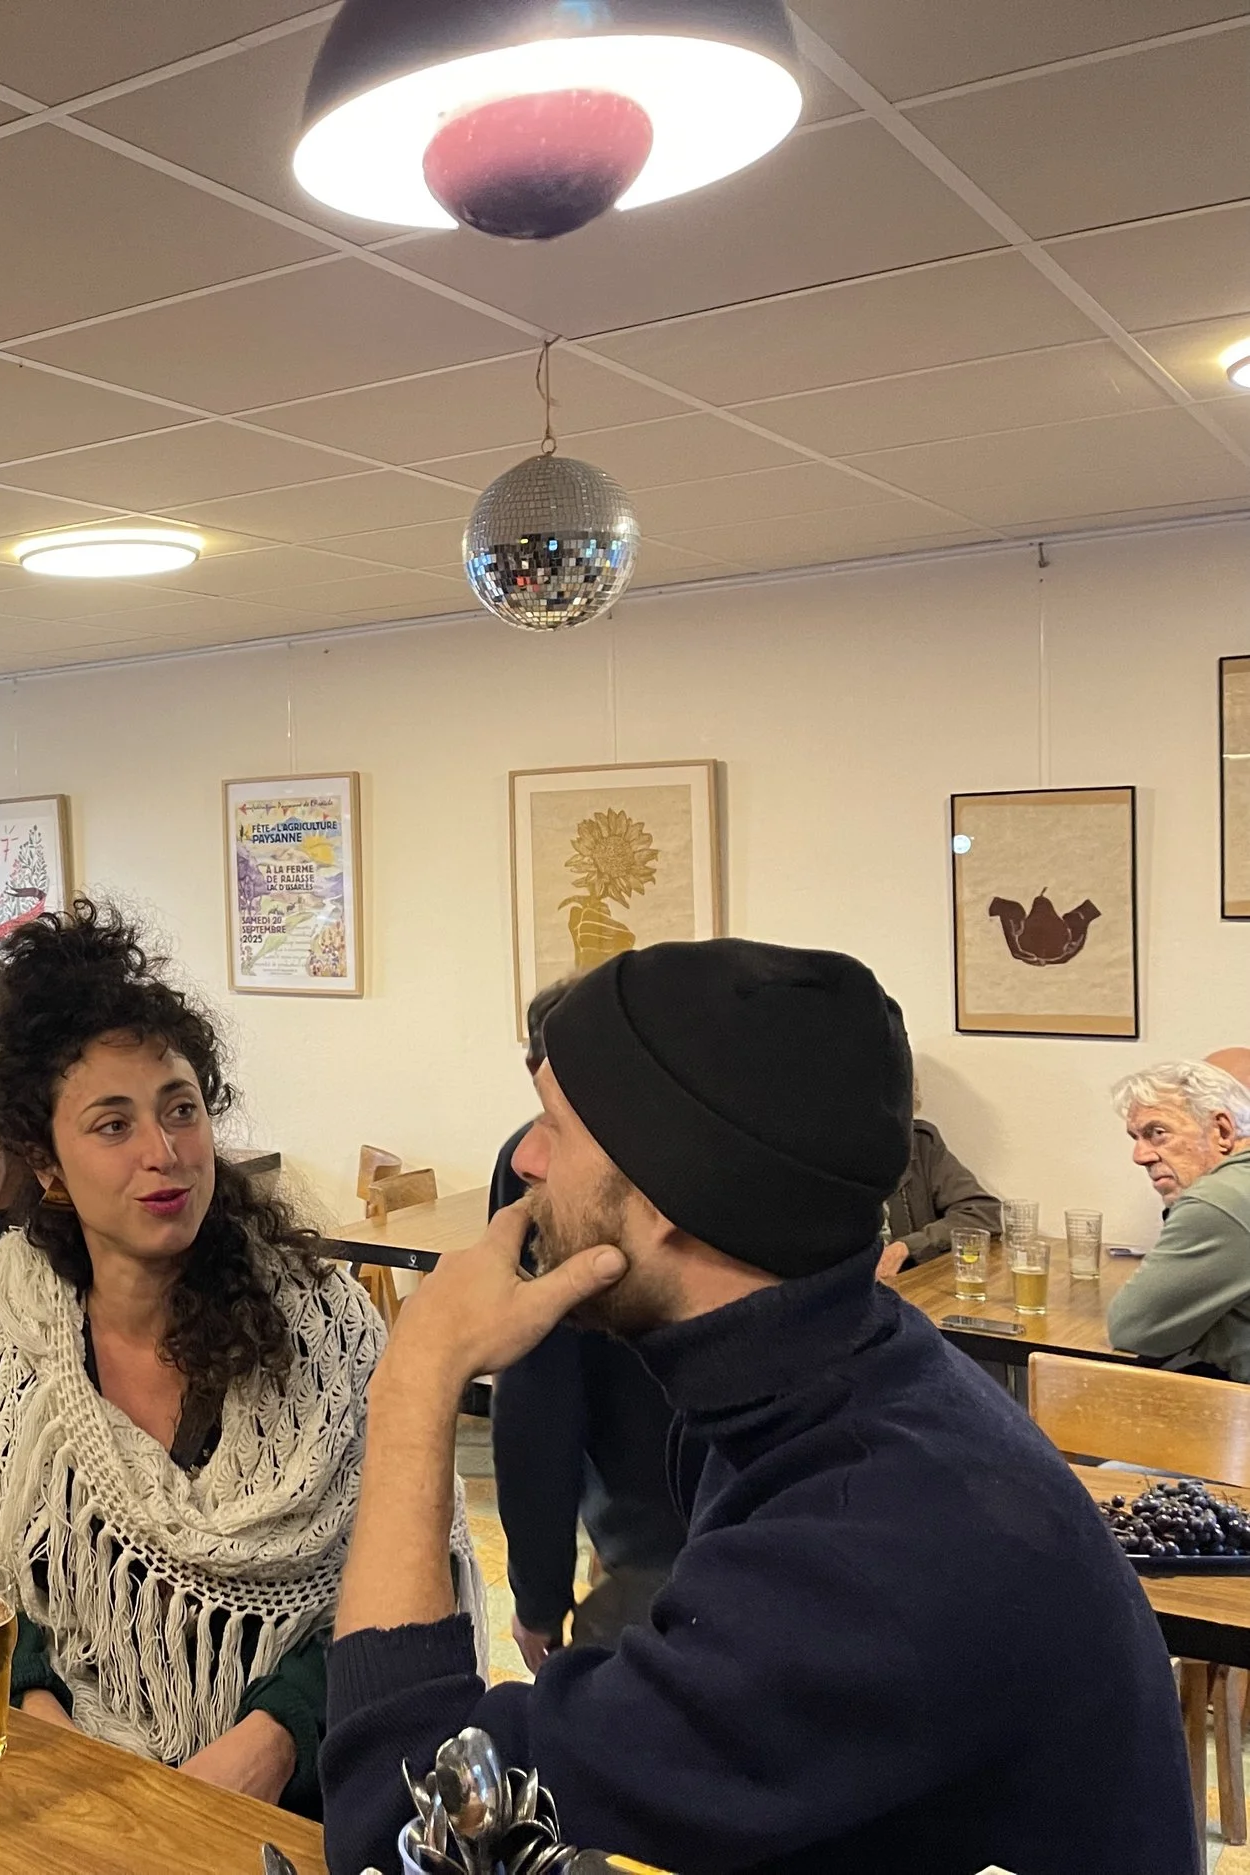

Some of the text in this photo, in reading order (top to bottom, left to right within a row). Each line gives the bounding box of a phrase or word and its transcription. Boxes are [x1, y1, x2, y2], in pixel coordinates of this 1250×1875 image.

[252, 823, 270, 833] FÊTE
[276, 821, 338, 832] L'AGRICULTURE
[252, 832, 302, 844] PAYSANNE
[274, 865, 284, 874] LA
[286, 865, 314, 873] FERME
[266, 874, 314, 884] DE RAJASSE
[266, 883, 277, 891] LAC
[242, 925, 286, 934] SEPTEMBRE
[242, 935, 262, 943] 2025
